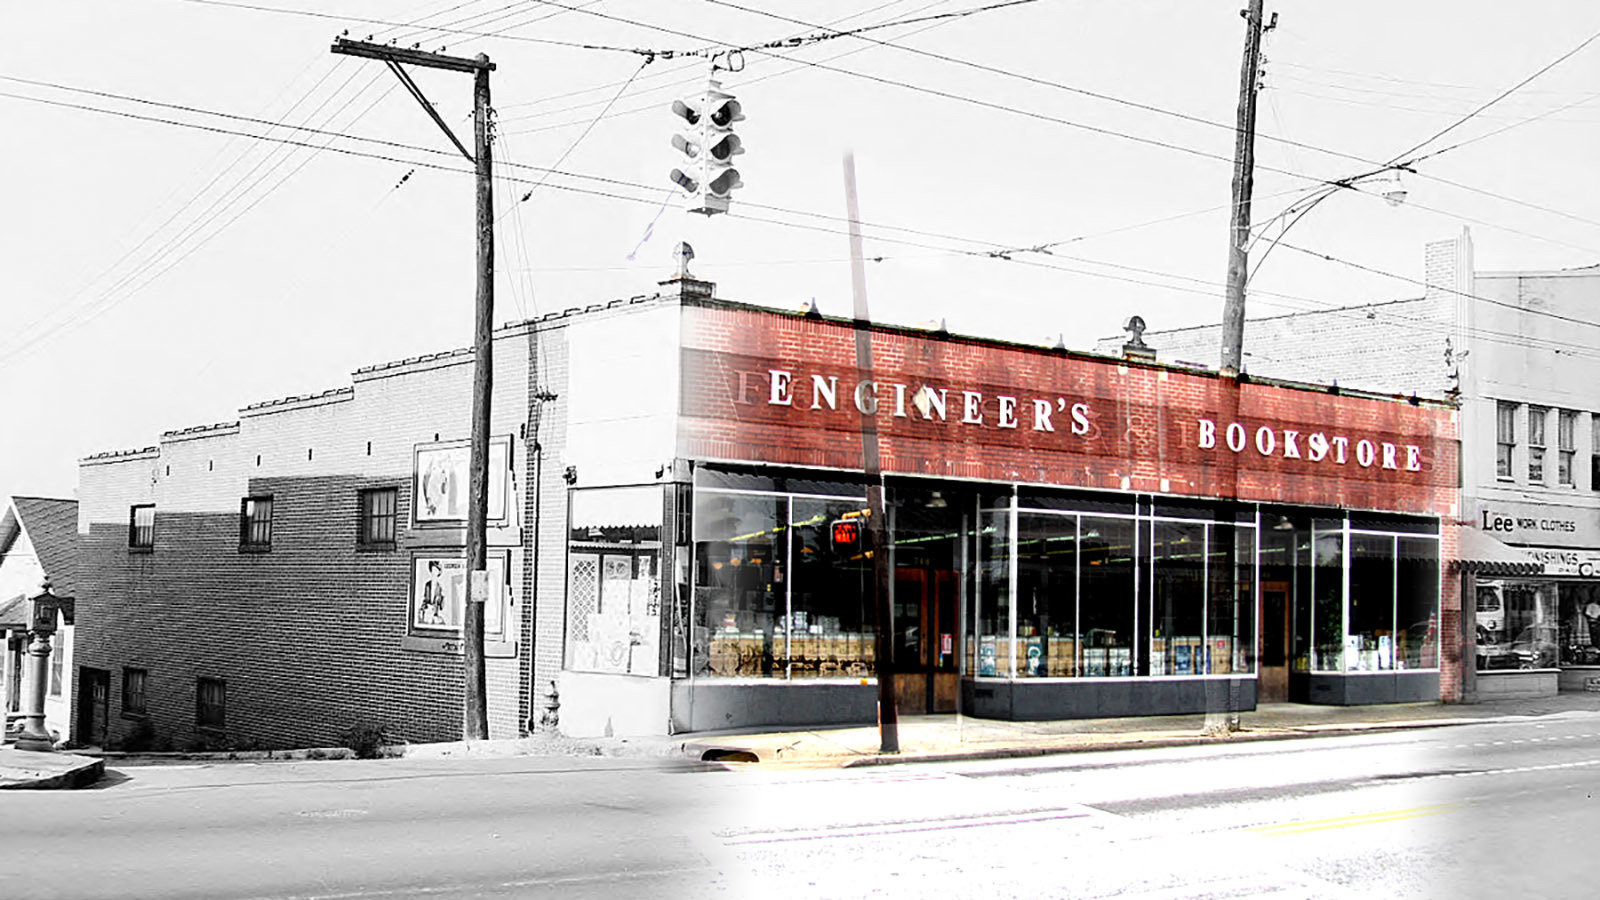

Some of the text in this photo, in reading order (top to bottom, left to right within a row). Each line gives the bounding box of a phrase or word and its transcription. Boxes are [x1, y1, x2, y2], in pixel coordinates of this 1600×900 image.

[767, 368, 1092, 436] ENGINEER'S
[1198, 419, 1422, 472] BOOKSTORE
[1481, 510, 1576, 532] Lee WORK CLOTHES
